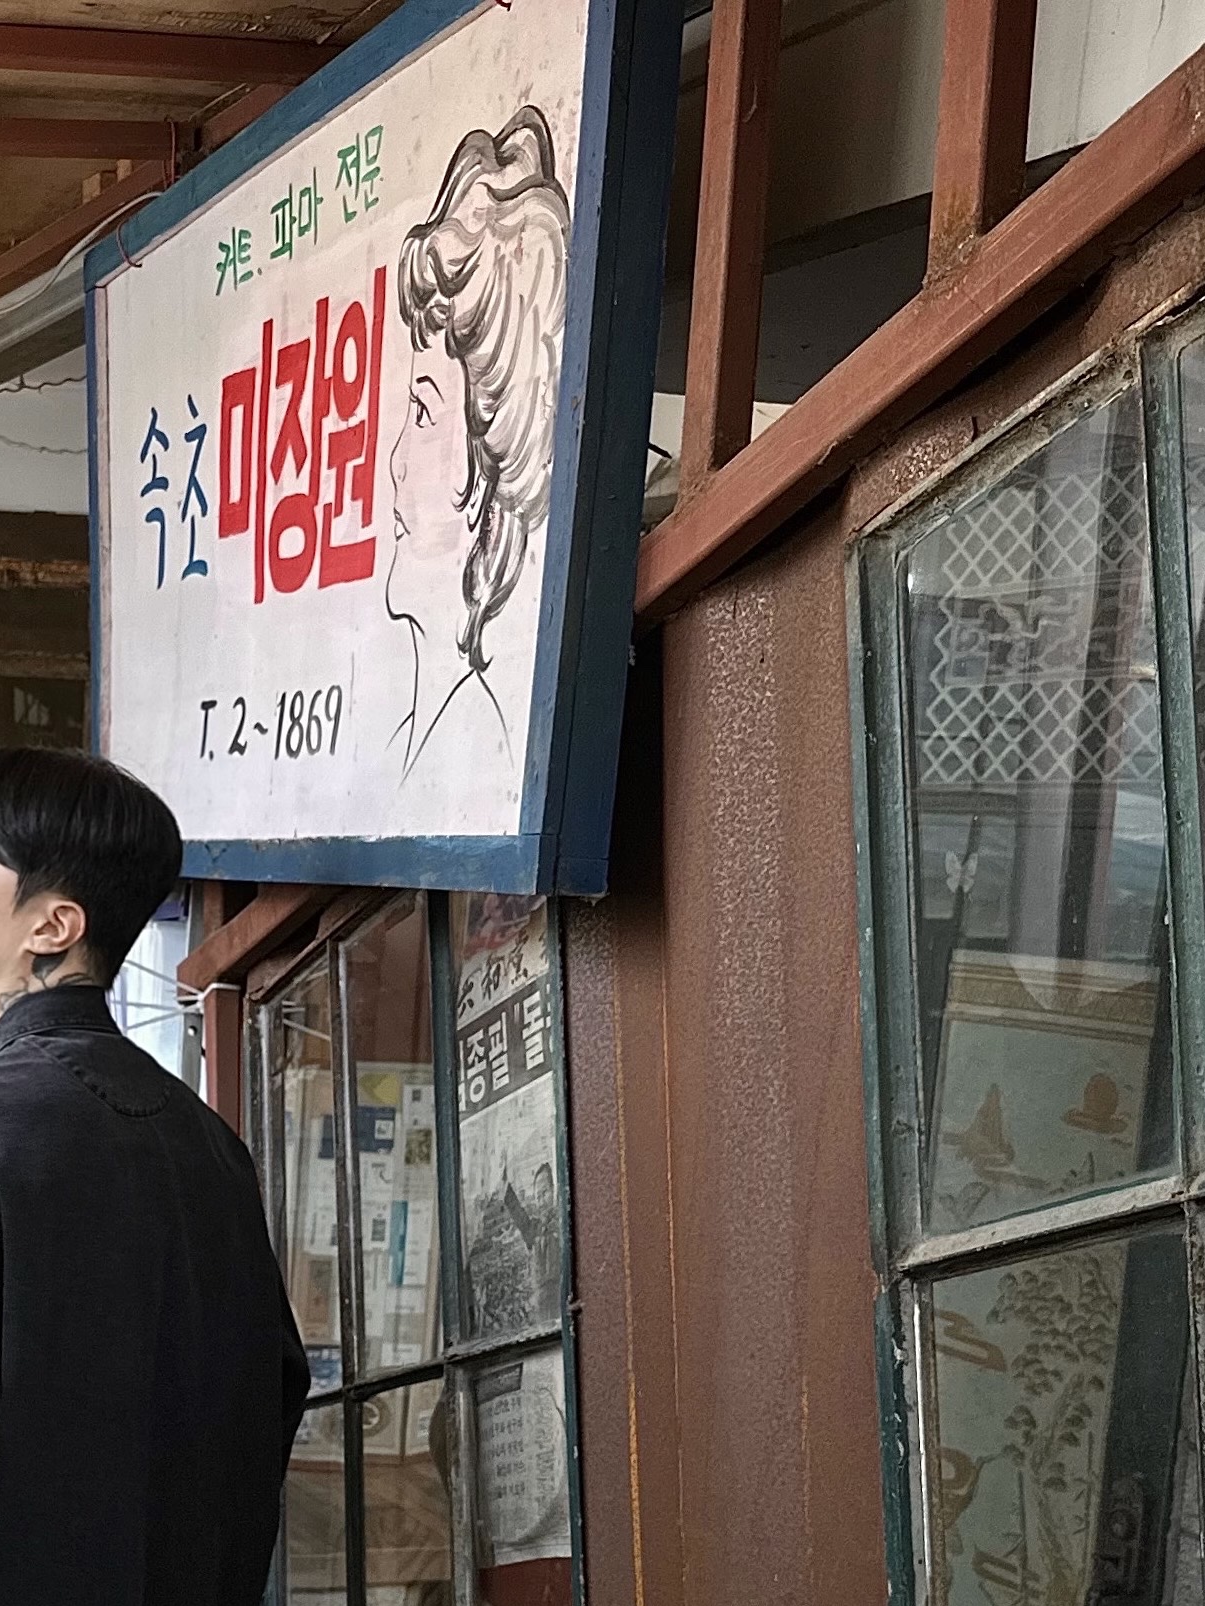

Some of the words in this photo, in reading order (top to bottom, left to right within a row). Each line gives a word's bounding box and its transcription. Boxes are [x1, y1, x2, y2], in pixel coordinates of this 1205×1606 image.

[269, 166, 324, 261] 파마
[334, 125, 384, 224] 전문
[139, 393, 209, 590] 속초
[218, 265, 388, 605] 미장원
[199, 699, 218, 762] T.
